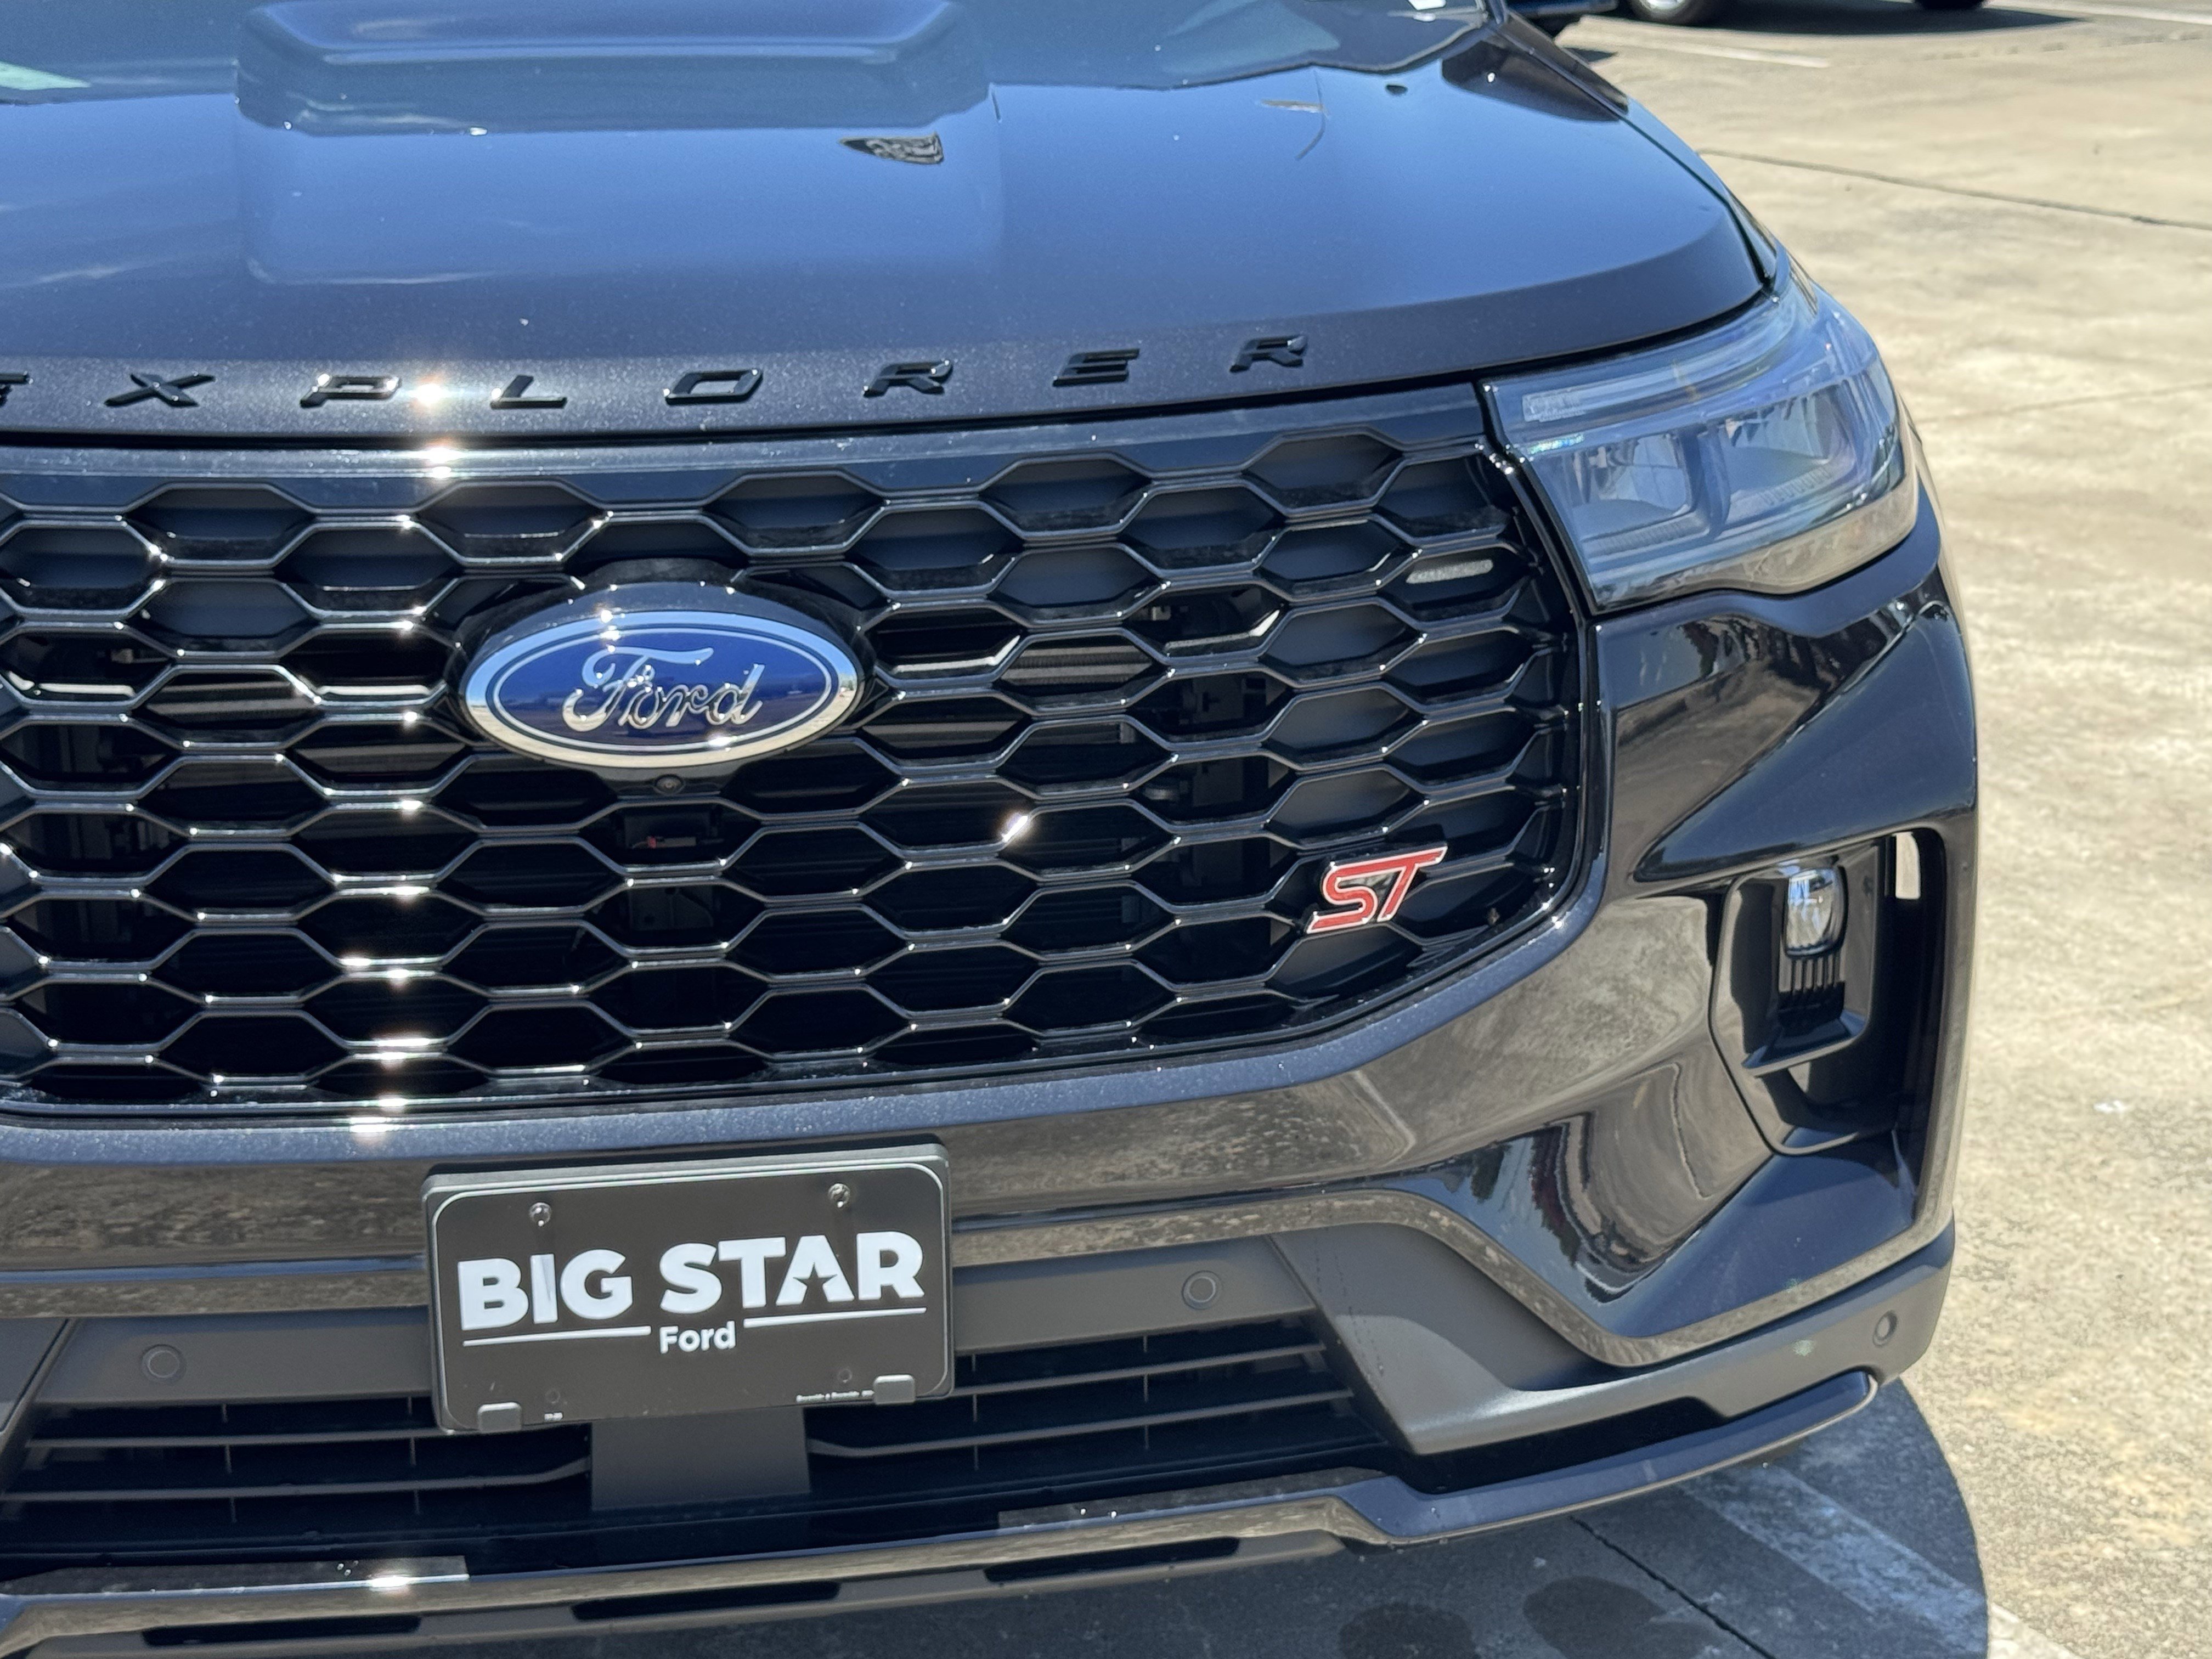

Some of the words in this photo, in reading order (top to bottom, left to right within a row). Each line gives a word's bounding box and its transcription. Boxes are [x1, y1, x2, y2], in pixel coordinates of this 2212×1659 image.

[0, 333, 1309, 409] XPLORER
[562, 646, 766, 732] Ford
[1305, 845, 1448, 934] ST
[458, 1248, 633, 1331] BIG
[659, 1231, 925, 1314] STAR
[658, 1320, 737, 1354] Ford
